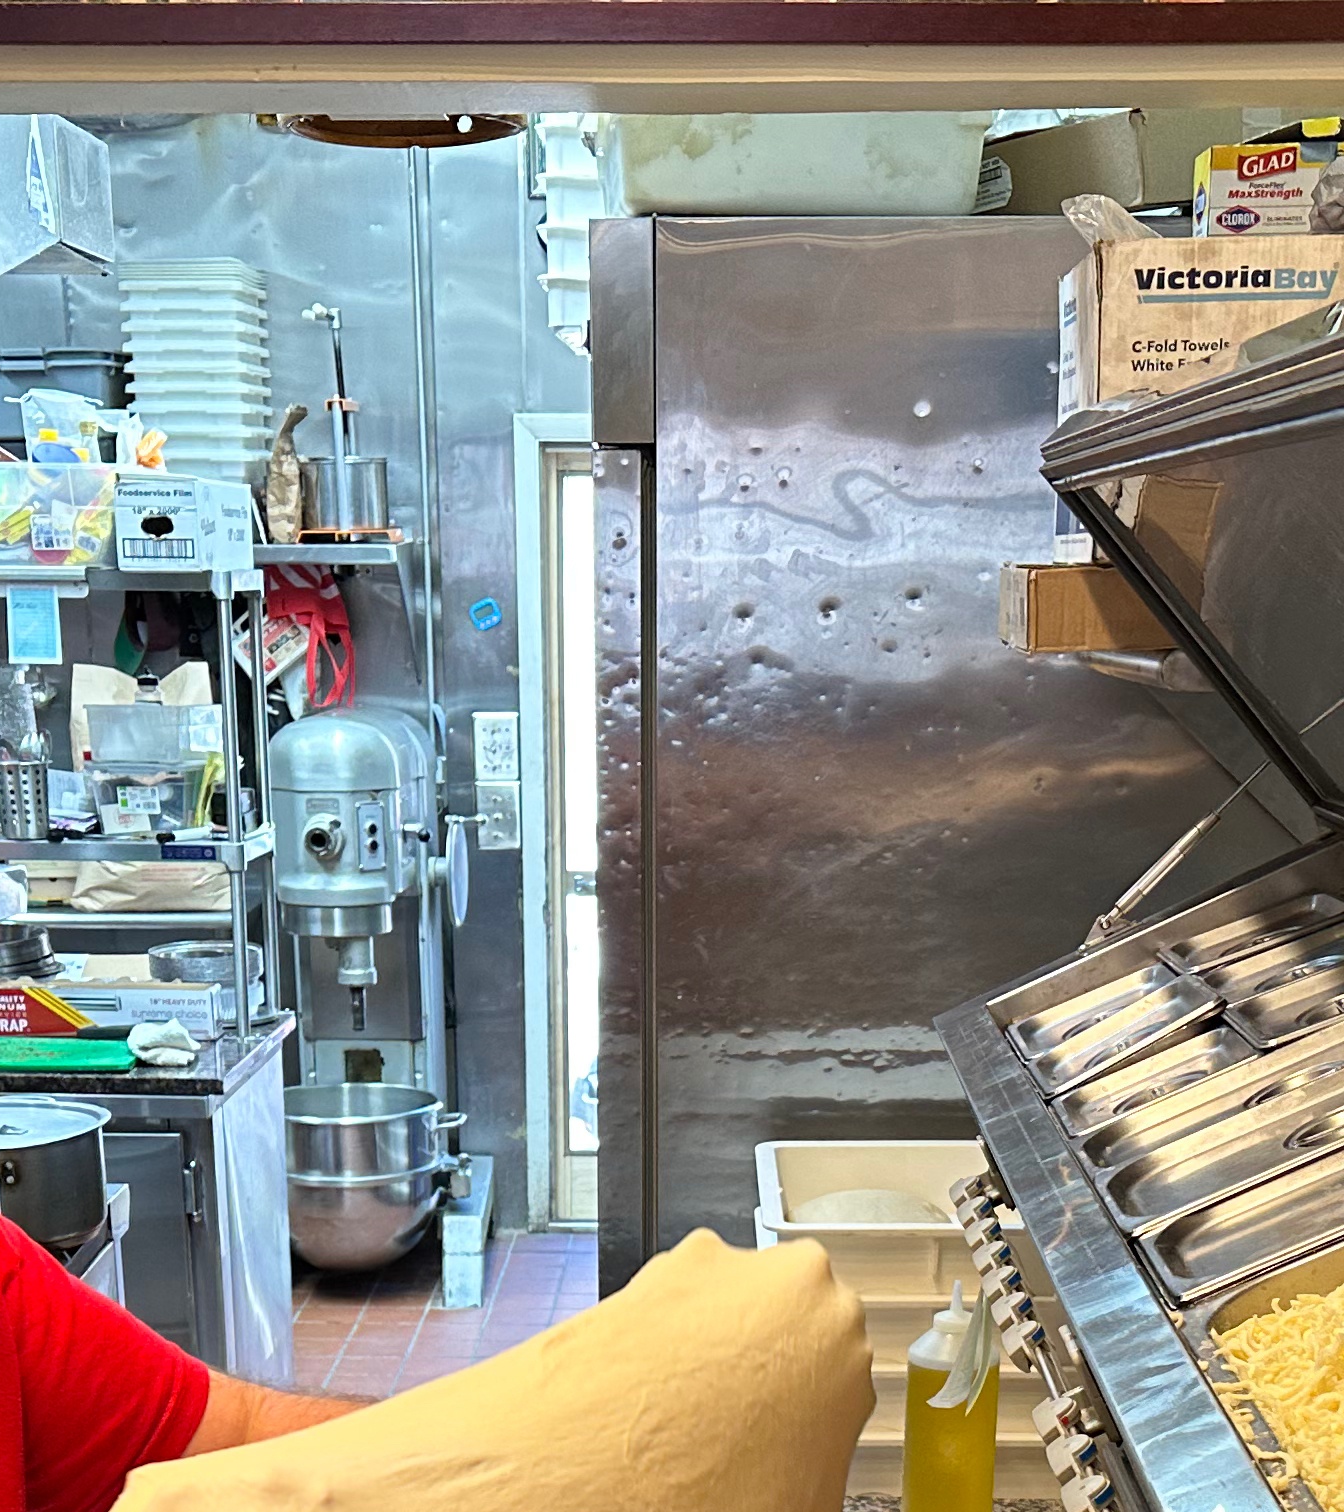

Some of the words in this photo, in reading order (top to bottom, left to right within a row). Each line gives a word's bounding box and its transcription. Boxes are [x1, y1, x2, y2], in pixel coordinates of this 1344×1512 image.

[1241, 150, 1295, 178] GLAD
[1227, 187, 1304, 200] MaxStrength
[1221, 213, 1257, 226] CLOROX
[1134, 265, 1339, 297] VictoriaBay
[1131, 339, 1178, 354] C-Fold
[1131, 358, 1174, 372] White
[117, 488, 171, 497] Foodservice
[173, 489, 193, 498] Film
[162, 998, 186, 1006] HEAVY
[187, 998, 207, 1006] DUTY
